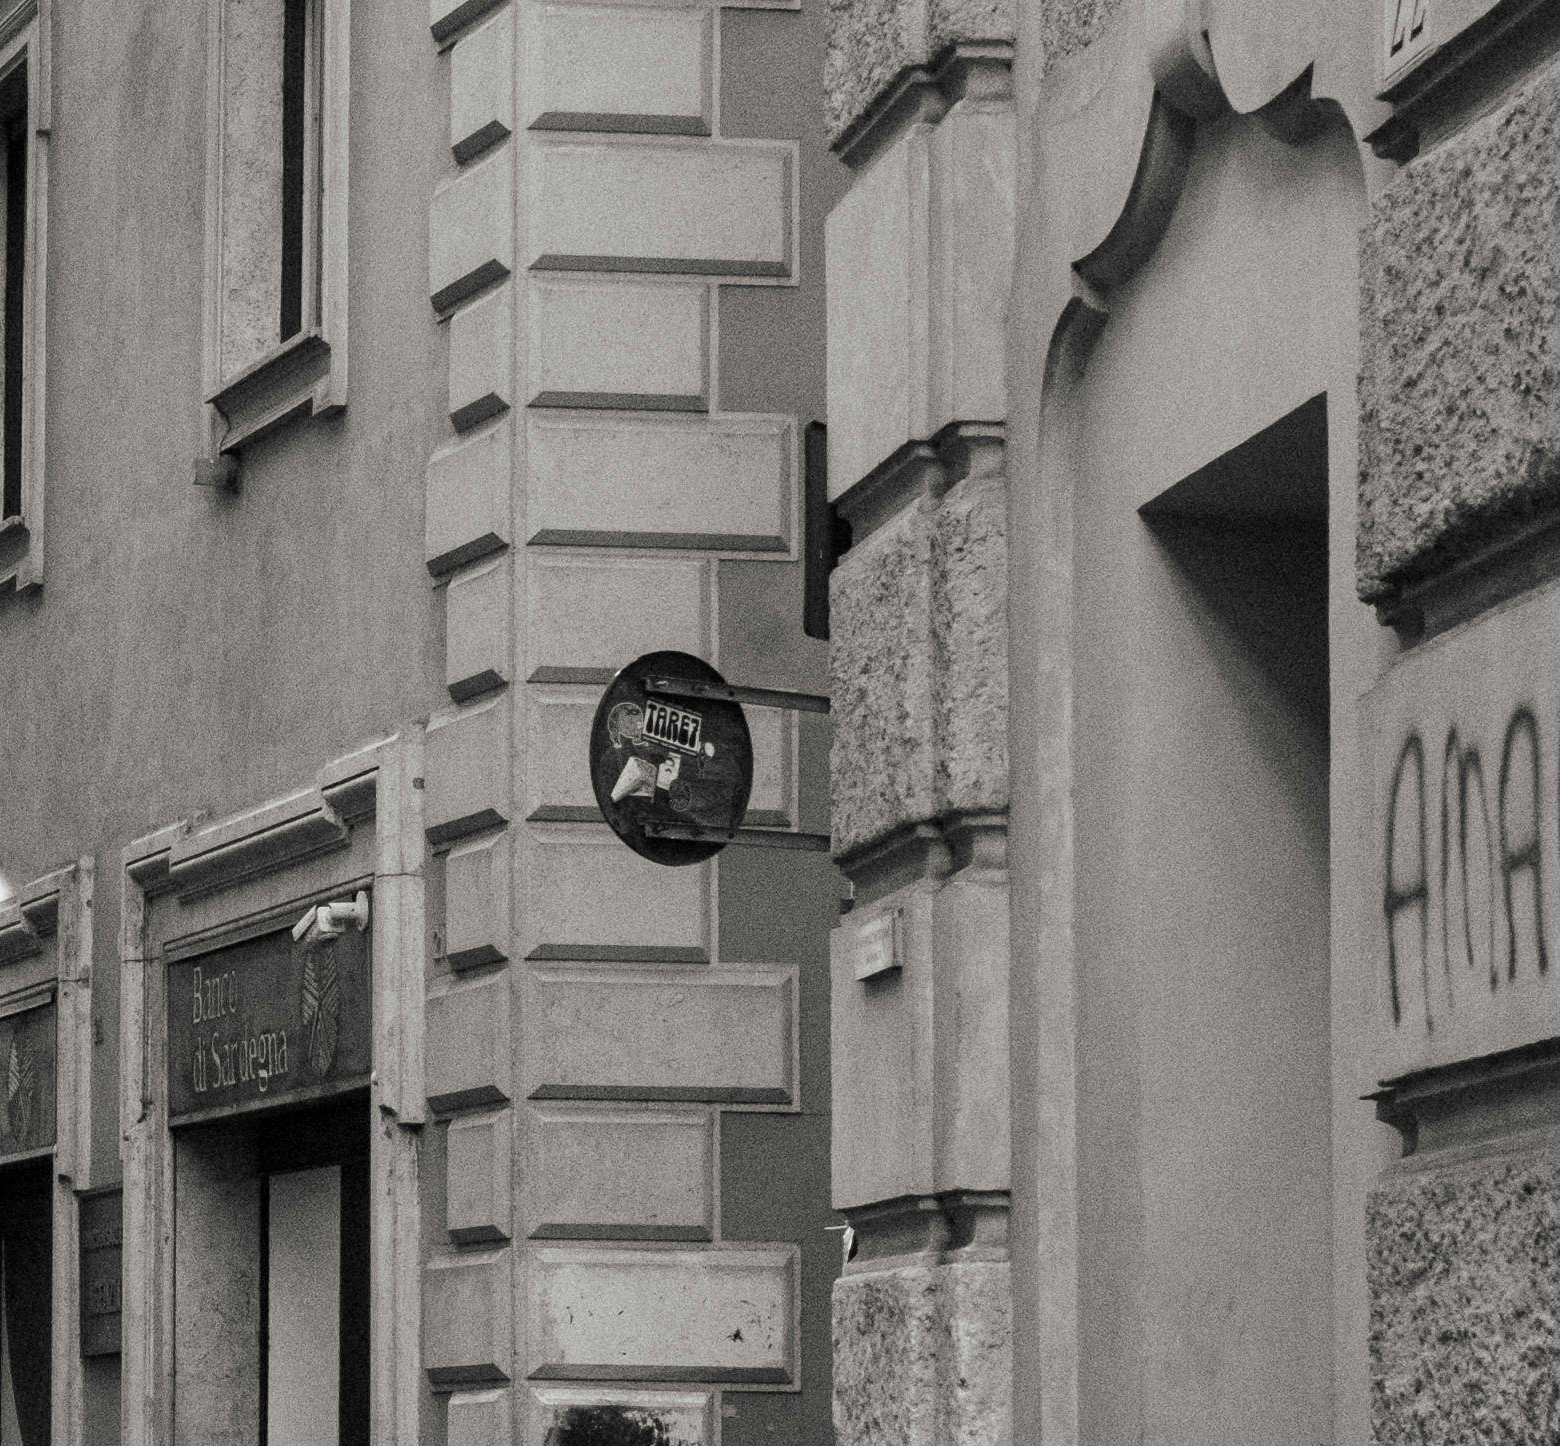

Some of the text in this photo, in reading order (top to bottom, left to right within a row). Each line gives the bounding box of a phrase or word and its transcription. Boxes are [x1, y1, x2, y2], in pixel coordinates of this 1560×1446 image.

[192, 966, 240, 1024] Banco
[192, 1023, 289, 1093] di Sardegna
